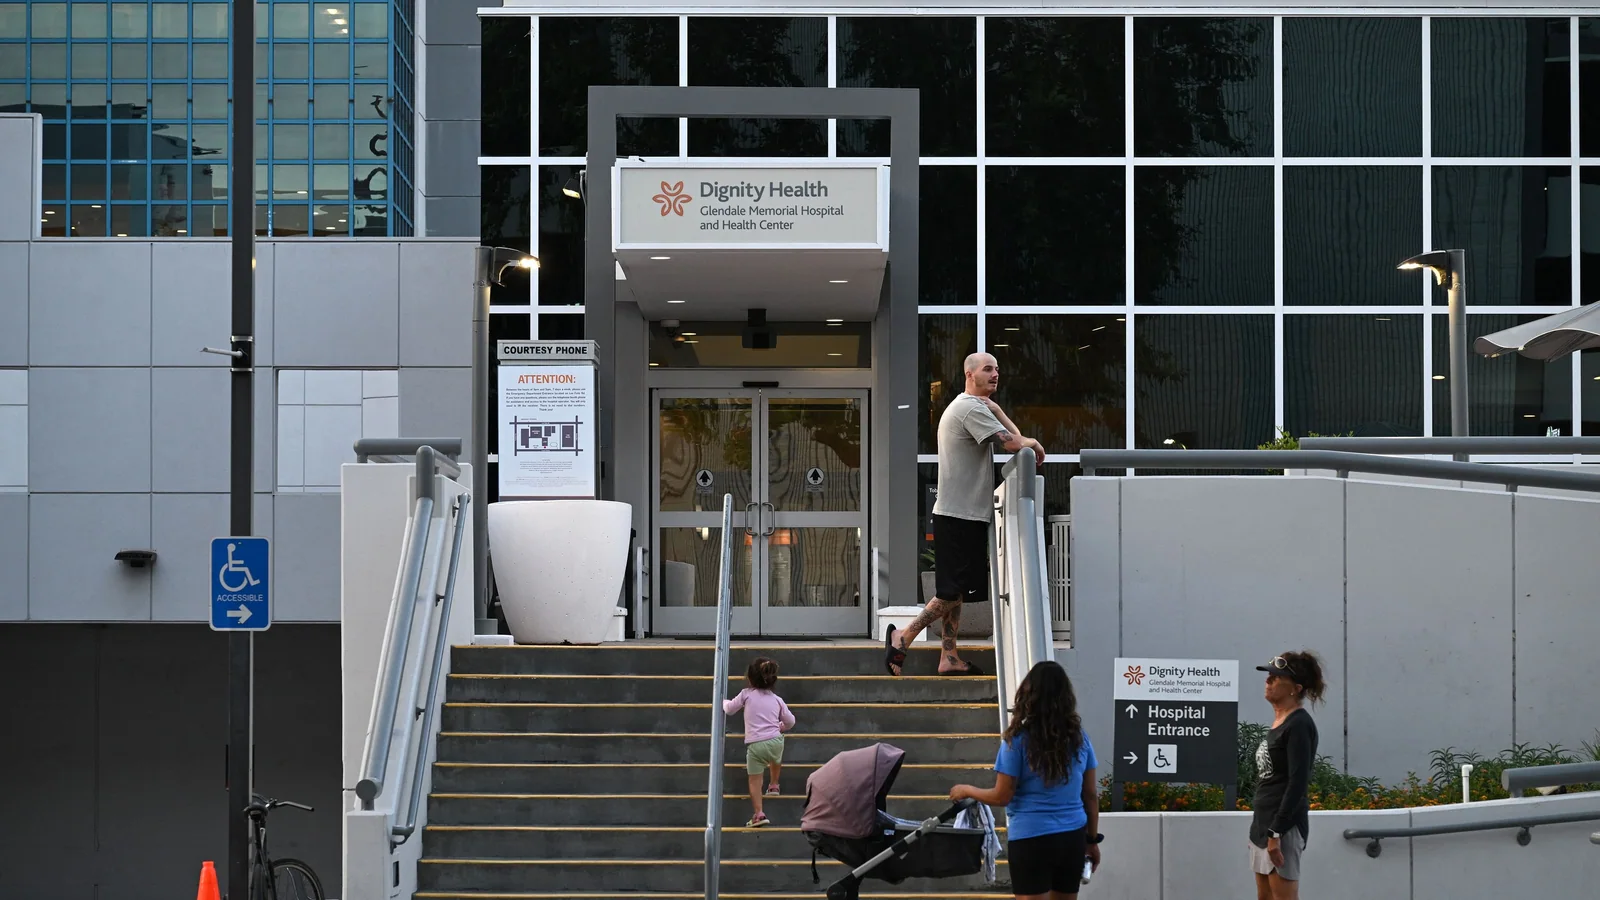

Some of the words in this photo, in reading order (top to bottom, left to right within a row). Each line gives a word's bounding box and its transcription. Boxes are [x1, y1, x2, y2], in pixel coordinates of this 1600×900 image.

[700, 181, 766, 202] Dignity
[769, 181, 828, 197] Health
[699, 205, 746, 216] Glendale
[749, 205, 798, 216] Memorial
[801, 205, 844, 217] Hospital
[700, 220, 719, 230] and
[722, 219, 757, 230] Health
[759, 220, 794, 230] Center
[503, 346, 553, 355] COURTESY
[555, 346, 588, 355] PHONE
[517, 374, 576, 384] ATTENTION:
[1149, 666, 1185, 678] Dignity
[1187, 667, 1220, 677] Health
[1148, 705, 1206, 721] Hospital
[1148, 723, 1210, 737] Entrance
